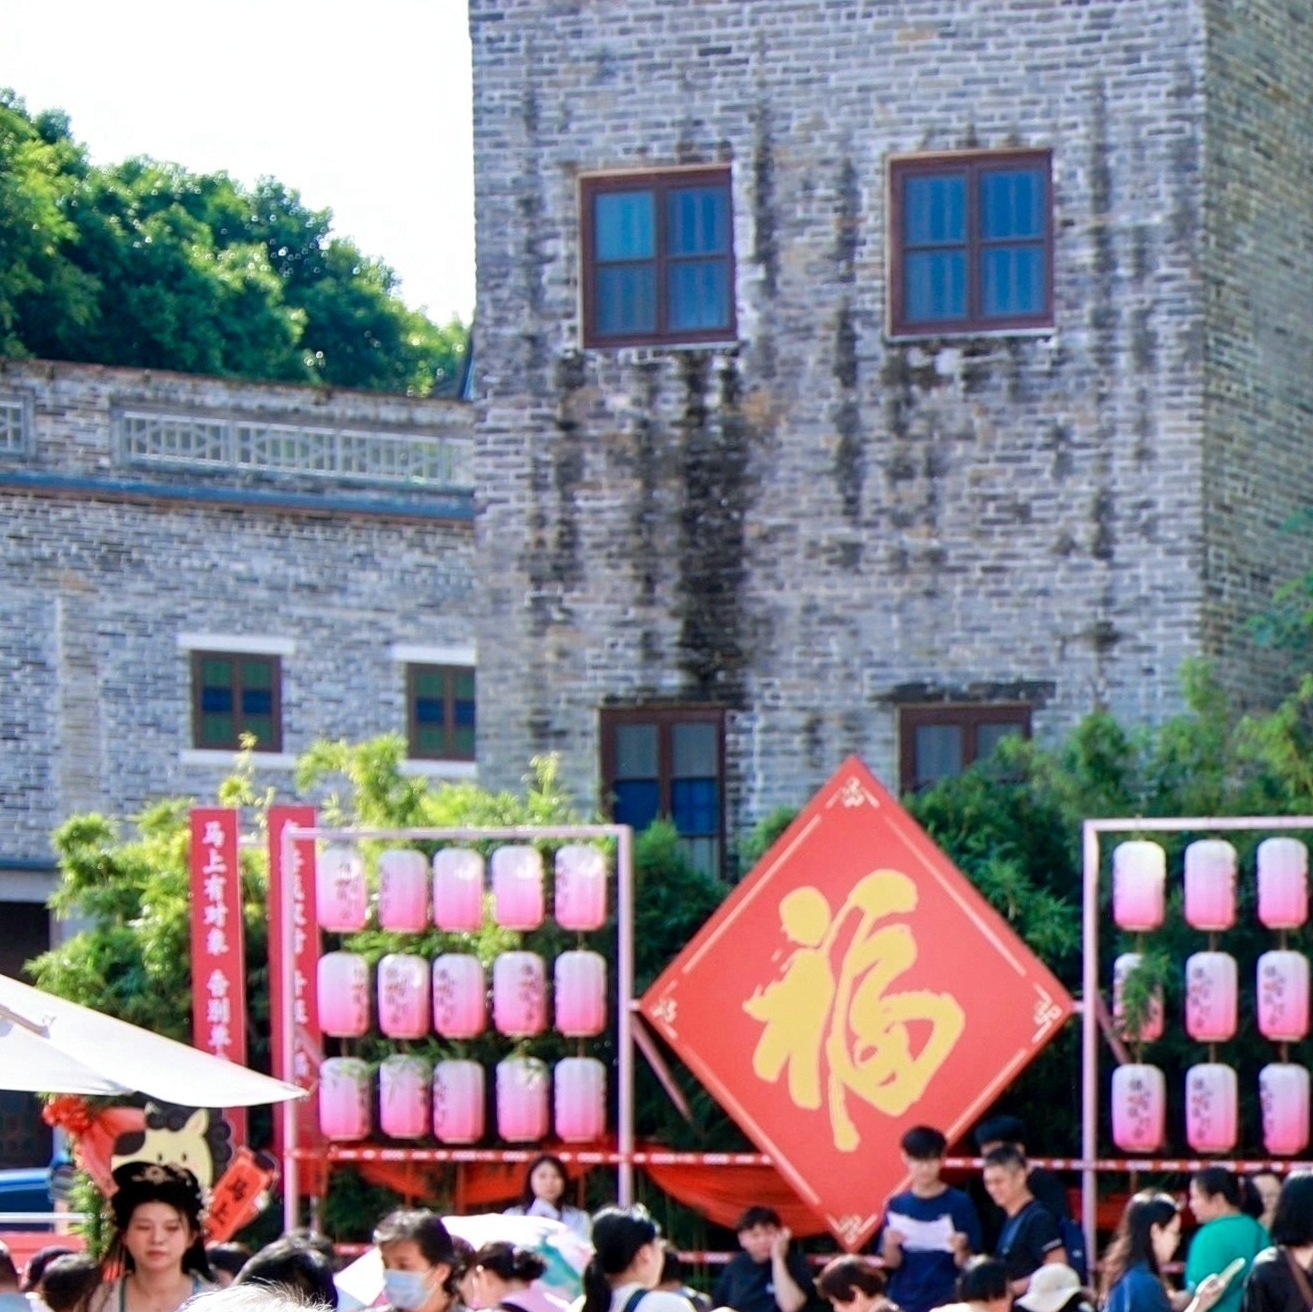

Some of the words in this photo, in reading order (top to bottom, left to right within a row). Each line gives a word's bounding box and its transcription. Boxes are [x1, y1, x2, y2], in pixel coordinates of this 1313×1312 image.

[202, 820, 230, 957] 马上有对象
[206, 968, 232, 1060] 告别单
[743, 868, 966, 1153] 福
